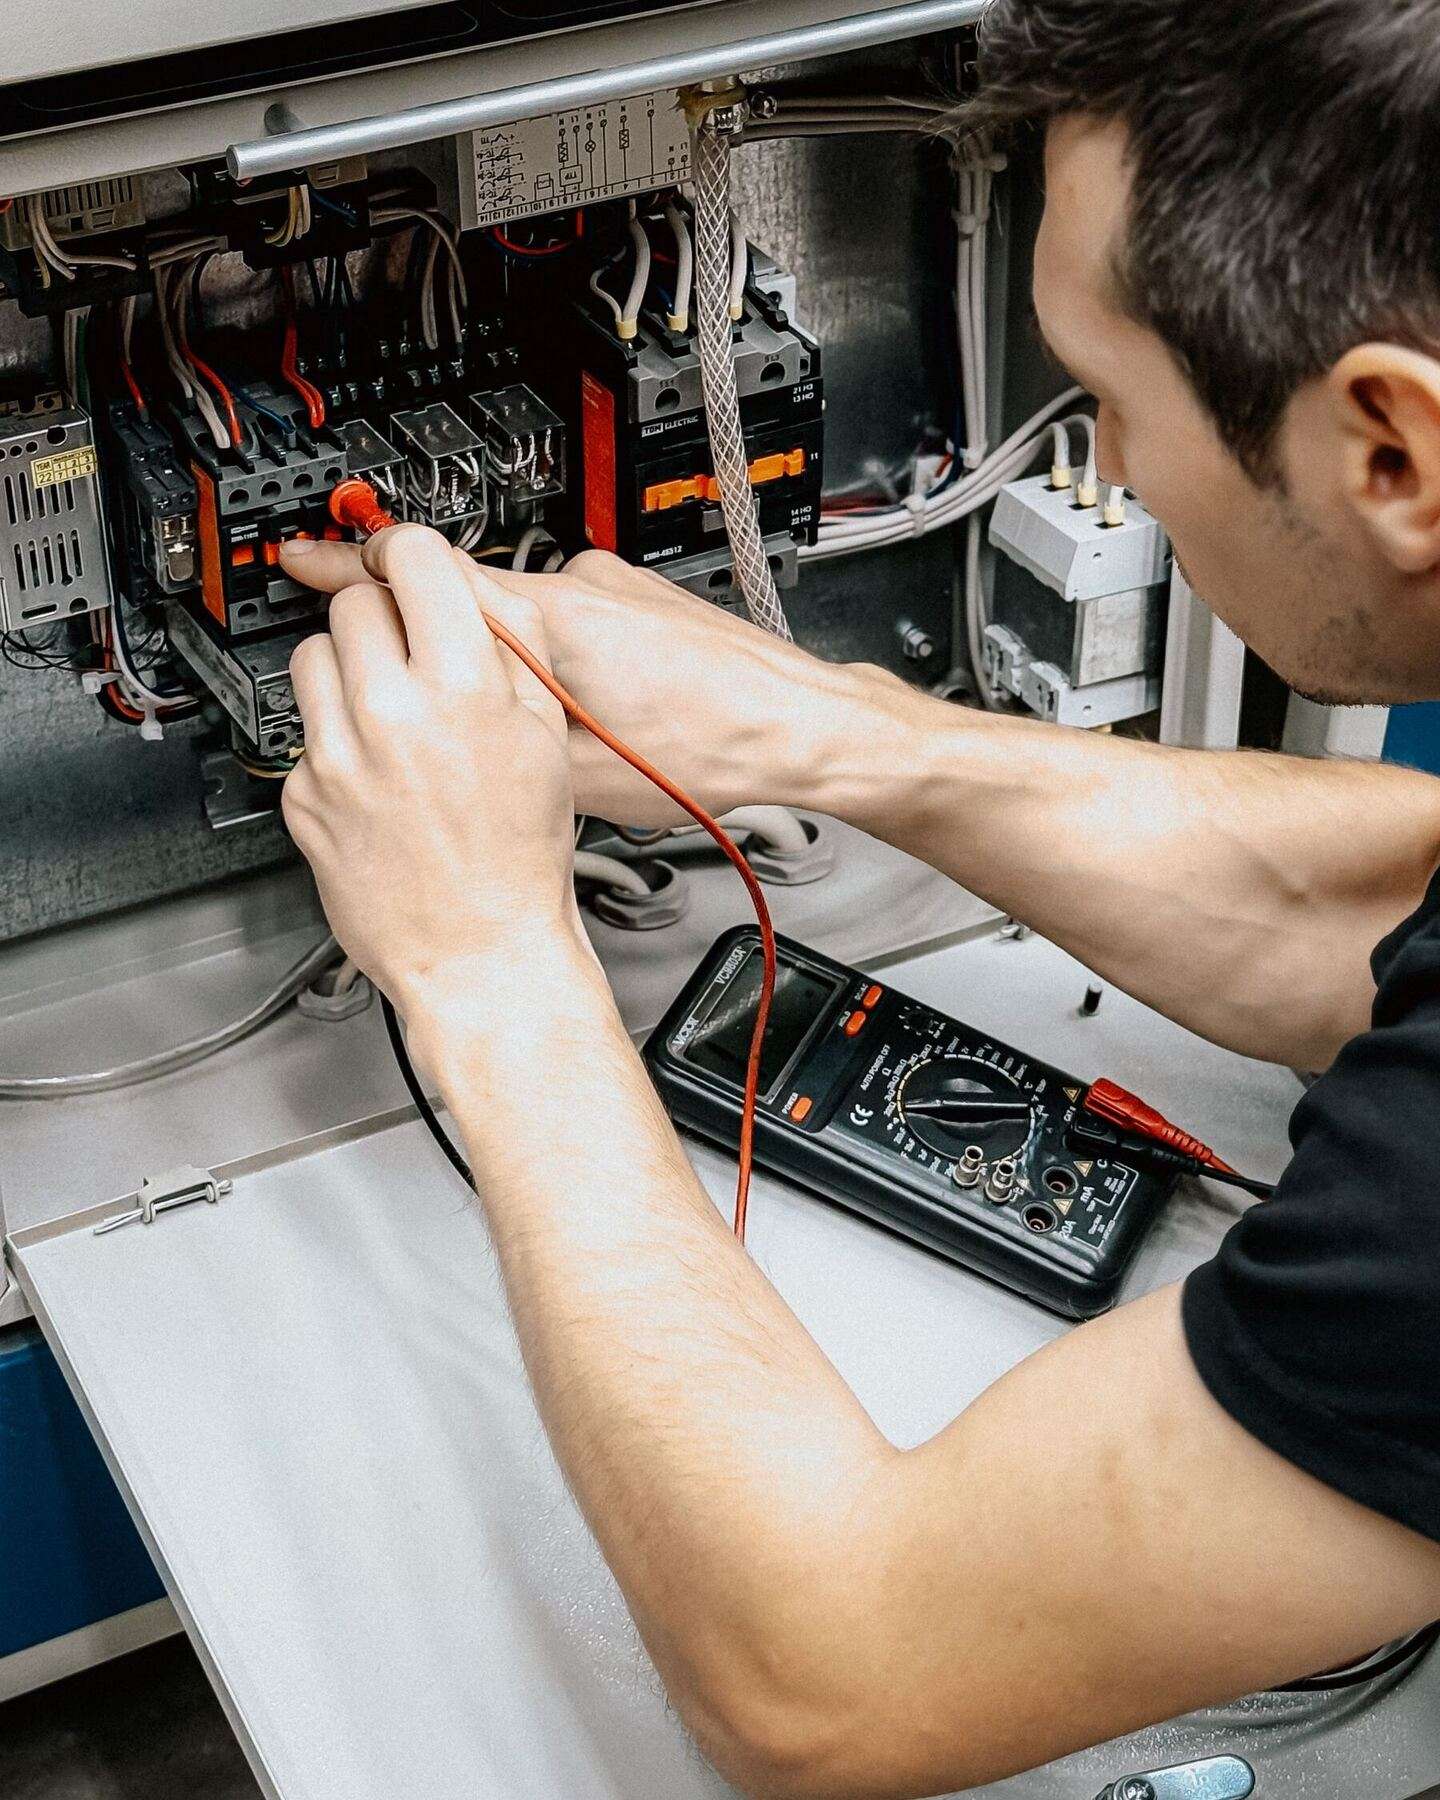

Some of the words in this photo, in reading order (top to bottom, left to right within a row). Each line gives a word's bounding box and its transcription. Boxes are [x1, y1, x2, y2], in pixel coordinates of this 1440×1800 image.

[665, 415, 699, 430] ELECTRIC
[36, 462, 51, 471] YEAR
[39, 473, 52, 483] 22
[860, 1073, 874, 1091] AUTO
[869, 1054, 886, 1076] POWER
[782, 1092, 799, 1115] POWER
[1060, 1220, 1077, 1239] 20A
